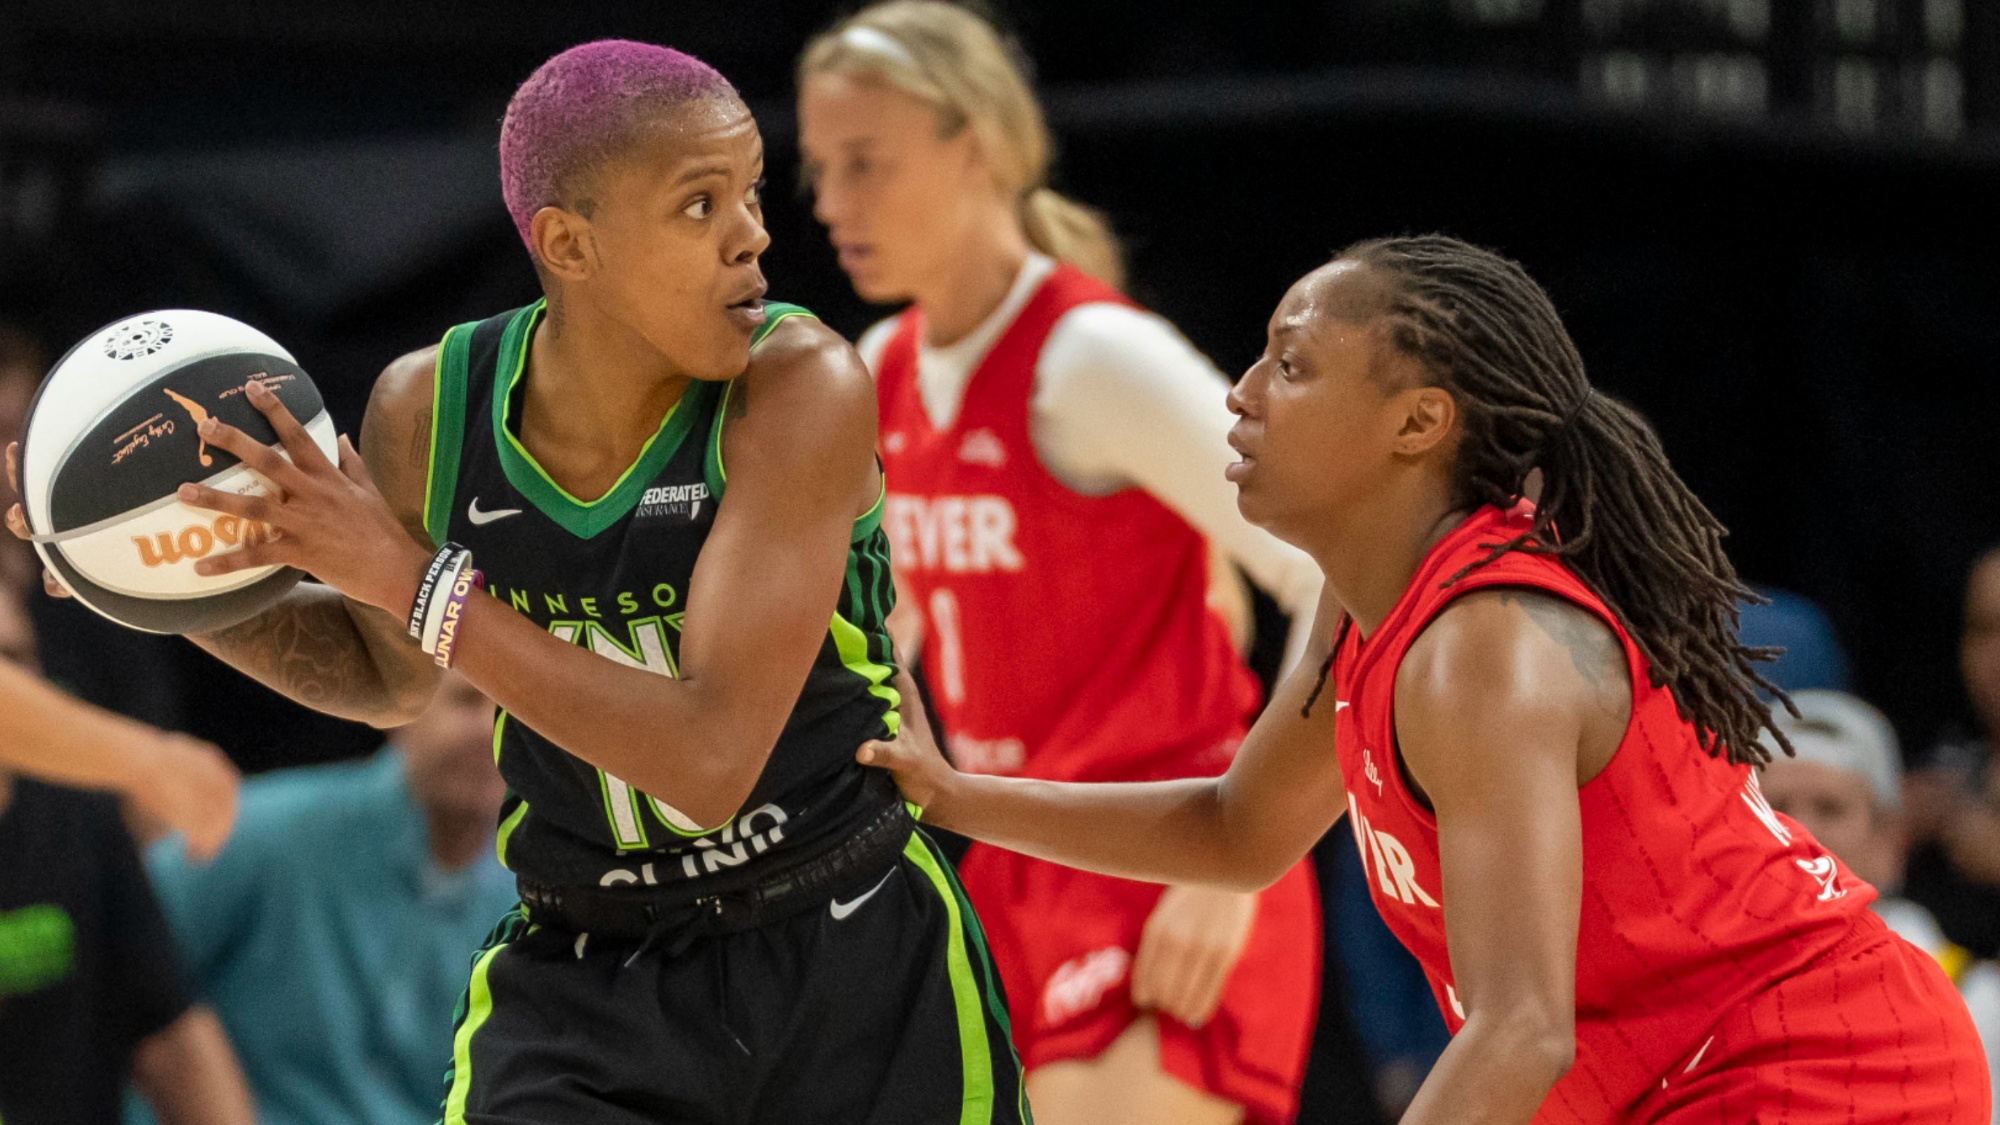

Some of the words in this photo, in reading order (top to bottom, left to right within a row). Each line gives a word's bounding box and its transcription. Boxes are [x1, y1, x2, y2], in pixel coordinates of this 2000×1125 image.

[131, 514, 268, 567] son
[885, 493, 1026, 574] EVER
[412, 582, 432, 620] BLACK
[424, 547, 453, 584] PERSON
[489, 583, 676, 618] INNESO
[436, 600, 462, 669] LUNAR
[1347, 791, 1441, 908] VER
